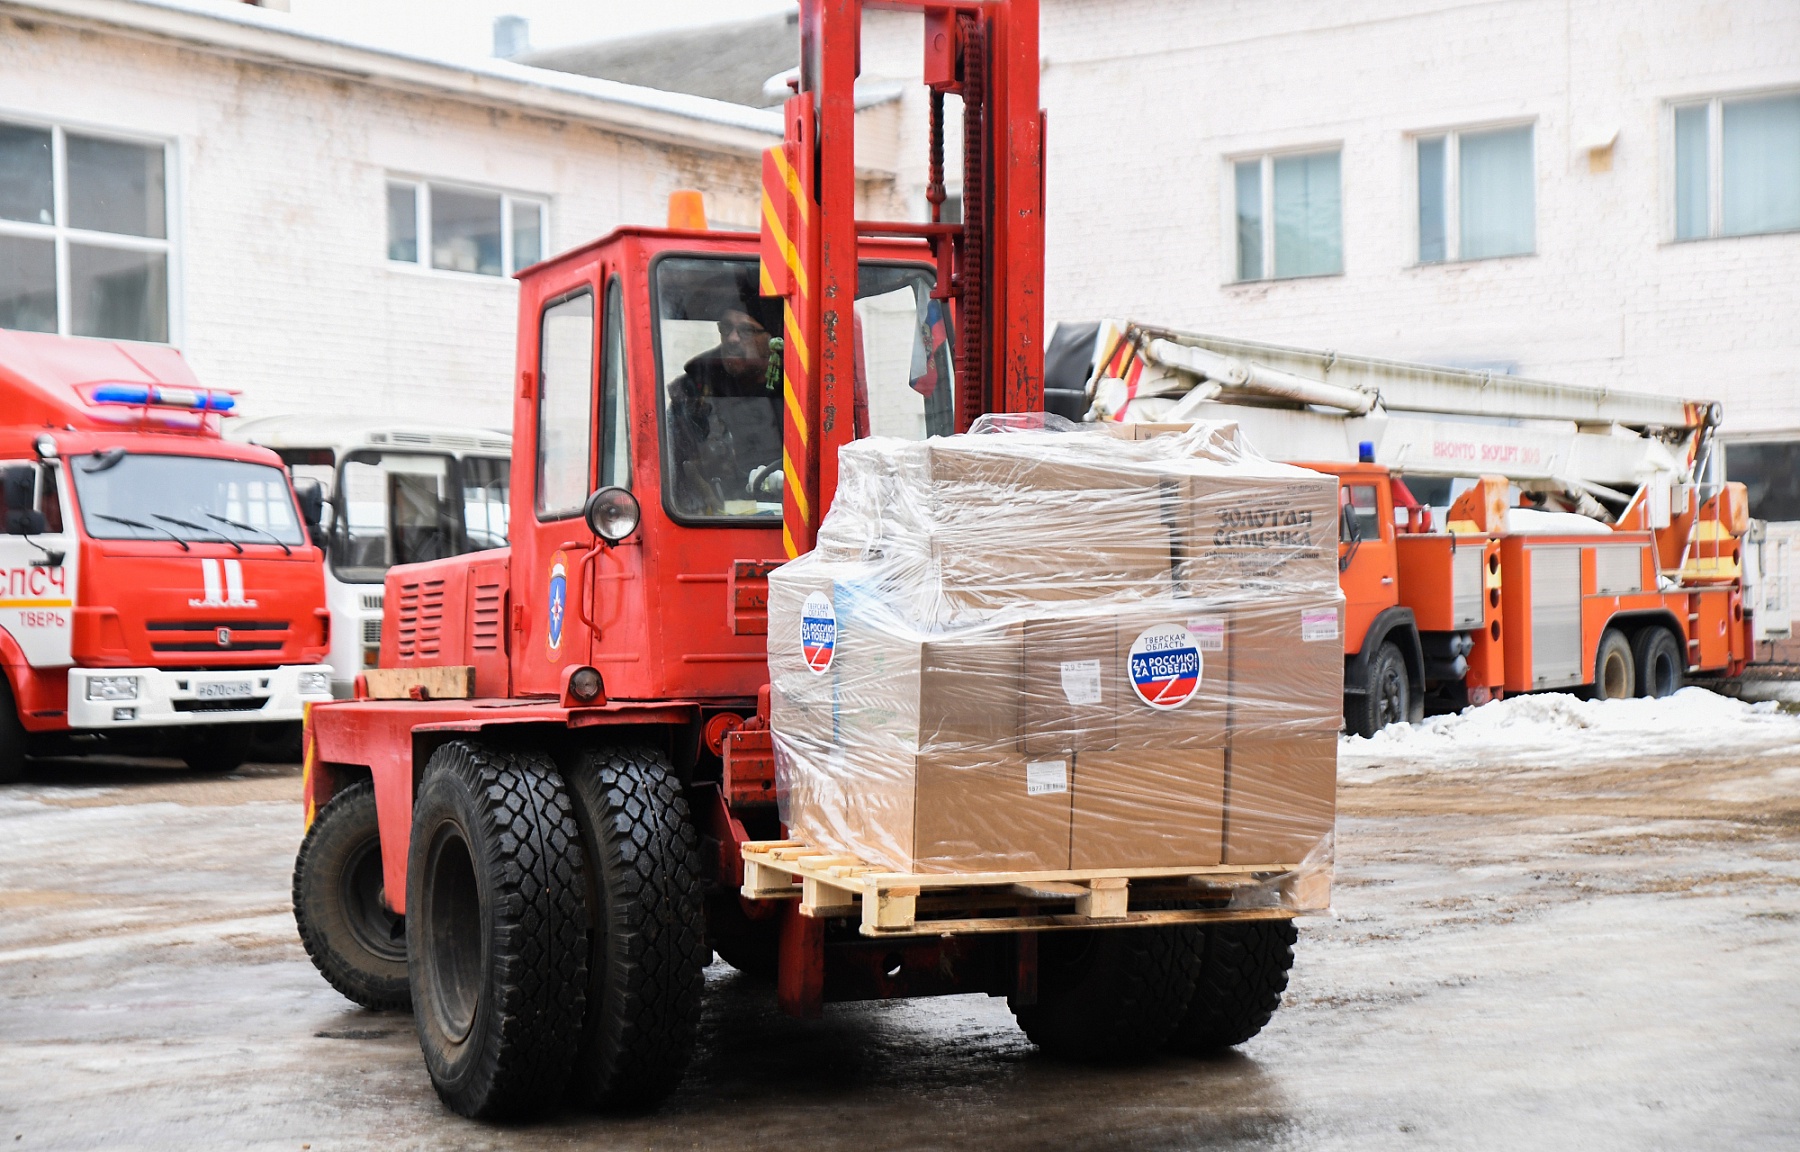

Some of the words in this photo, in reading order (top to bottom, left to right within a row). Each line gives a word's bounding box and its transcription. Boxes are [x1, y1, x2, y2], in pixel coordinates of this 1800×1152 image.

[1433, 440, 1476, 459] BRONTO
[1481, 443, 1519, 462] SKYLIFT
[1214, 508, 1312, 528] ЗОЛОТАЯ
[1213, 529, 1312, 547] СЕМЕЧКА
[808, 602, 829, 610] ТВЕРСКАЯ
[808, 609, 828, 617] ОБЛАСТЬ
[19, 611, 65, 627] ТВЕРЬ
[803, 622, 810, 632] ZA
[803, 631, 811, 640] ZA
[1144, 633, 1186, 645] ТВЕРСКАЯ
[1145, 640, 1185, 651] ОБЛАСТЬ
[1132, 658, 1147, 669] ZA
[1135, 667, 1150, 678] ZA
[1151, 673, 1188, 702] Z
